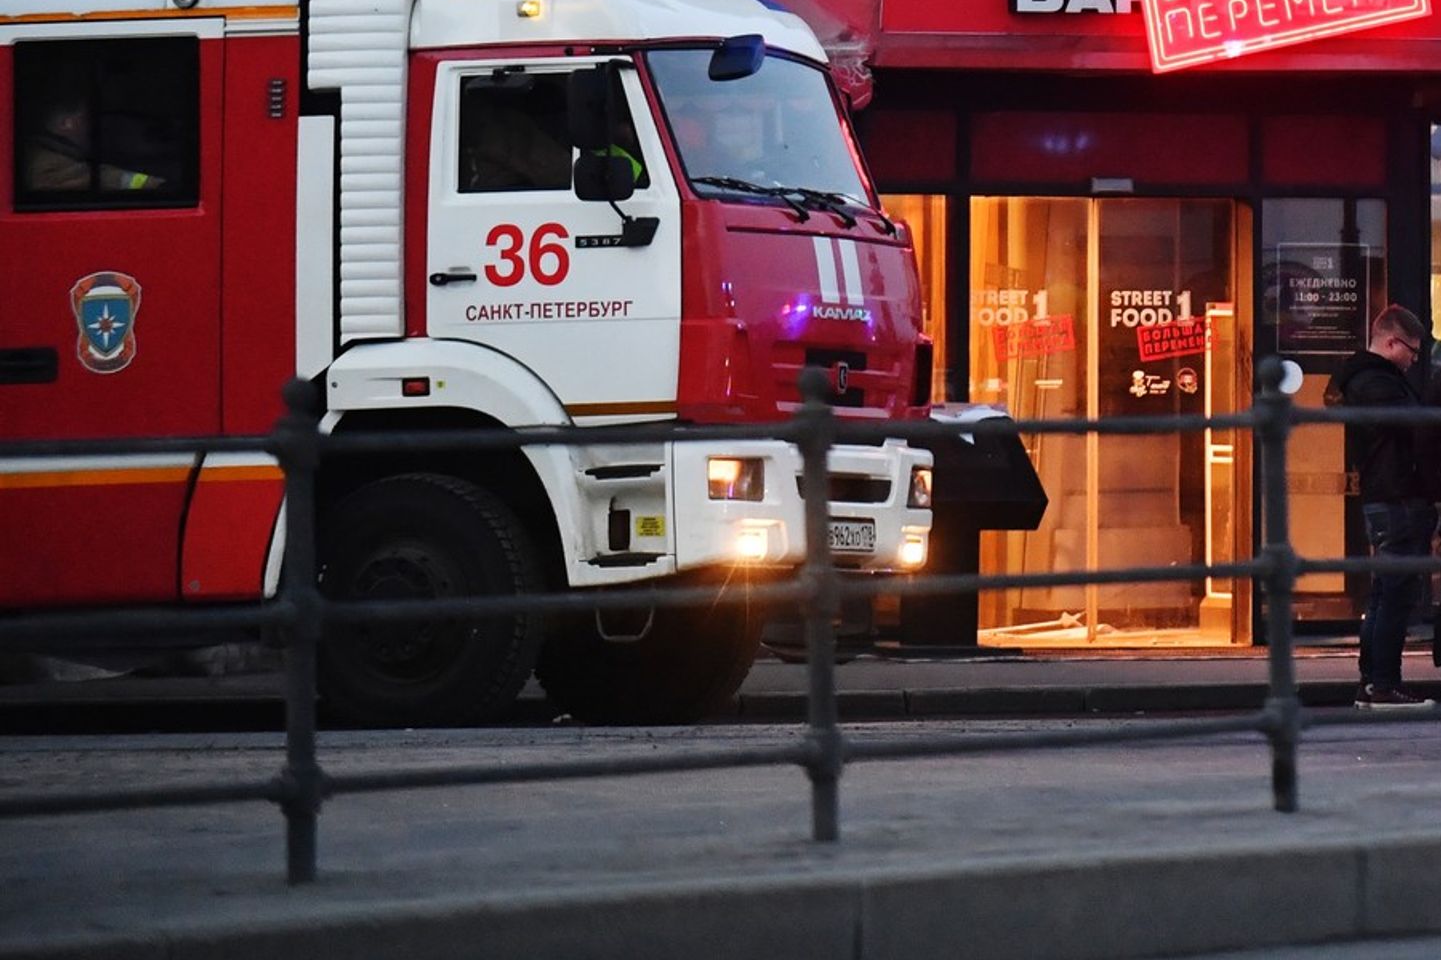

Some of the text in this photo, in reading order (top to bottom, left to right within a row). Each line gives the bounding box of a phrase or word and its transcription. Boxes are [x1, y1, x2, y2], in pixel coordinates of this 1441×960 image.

[484, 222, 570, 287] 36
[1289, 277, 1357, 289] ЕЖЕДНЕВНО
[1110, 290, 1173, 306] STREET
[1328, 292, 1358, 302] 23:00
[465, 300, 633, 321] САНКТ-ПЕТЕРБУРГ
[1033, 289, 1051, 327] 1
[1176, 290, 1195, 327] 1
[1110, 308, 1174, 328] FOOD
[1143, 323, 1205, 342] БОЛЬША
[1144, 335, 1206, 354] ПЕРЕМЕН
